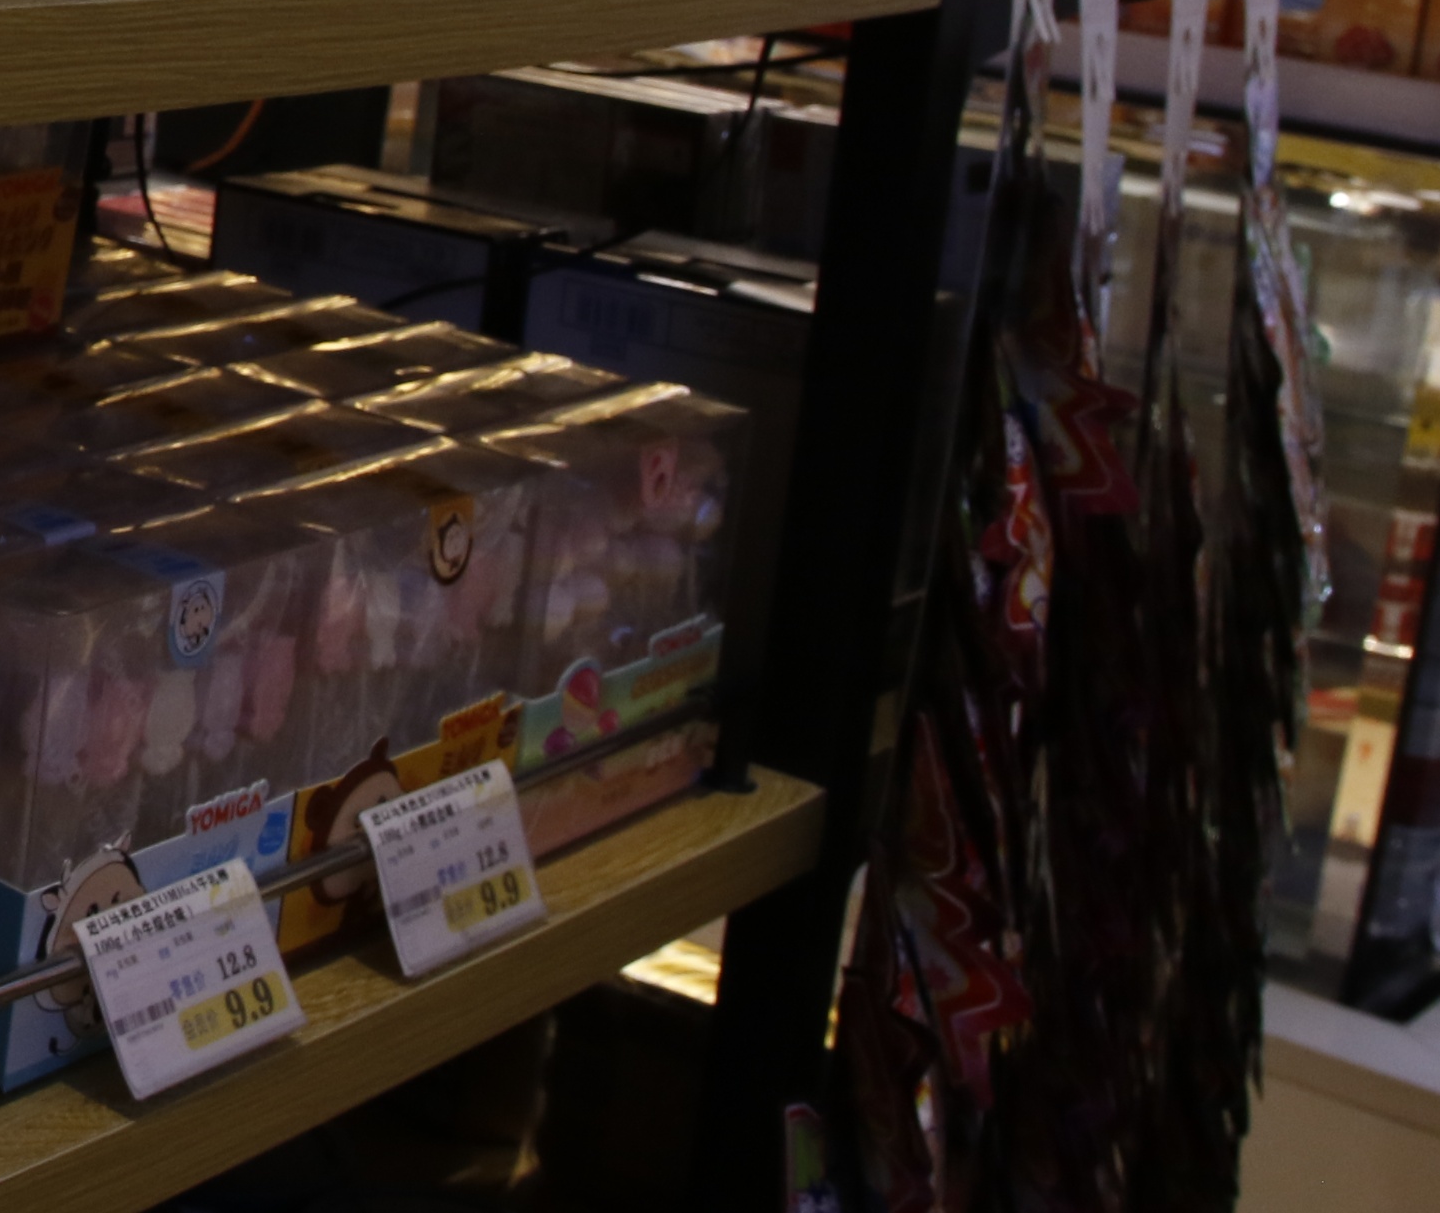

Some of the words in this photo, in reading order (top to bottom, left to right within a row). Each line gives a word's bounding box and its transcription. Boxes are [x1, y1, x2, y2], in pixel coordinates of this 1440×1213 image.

[189, 793, 263, 835] YOMIGA
[479, 870, 519, 916] 9.9
[216, 944, 258, 981] 12.8
[225, 977, 274, 1029] 9.9
